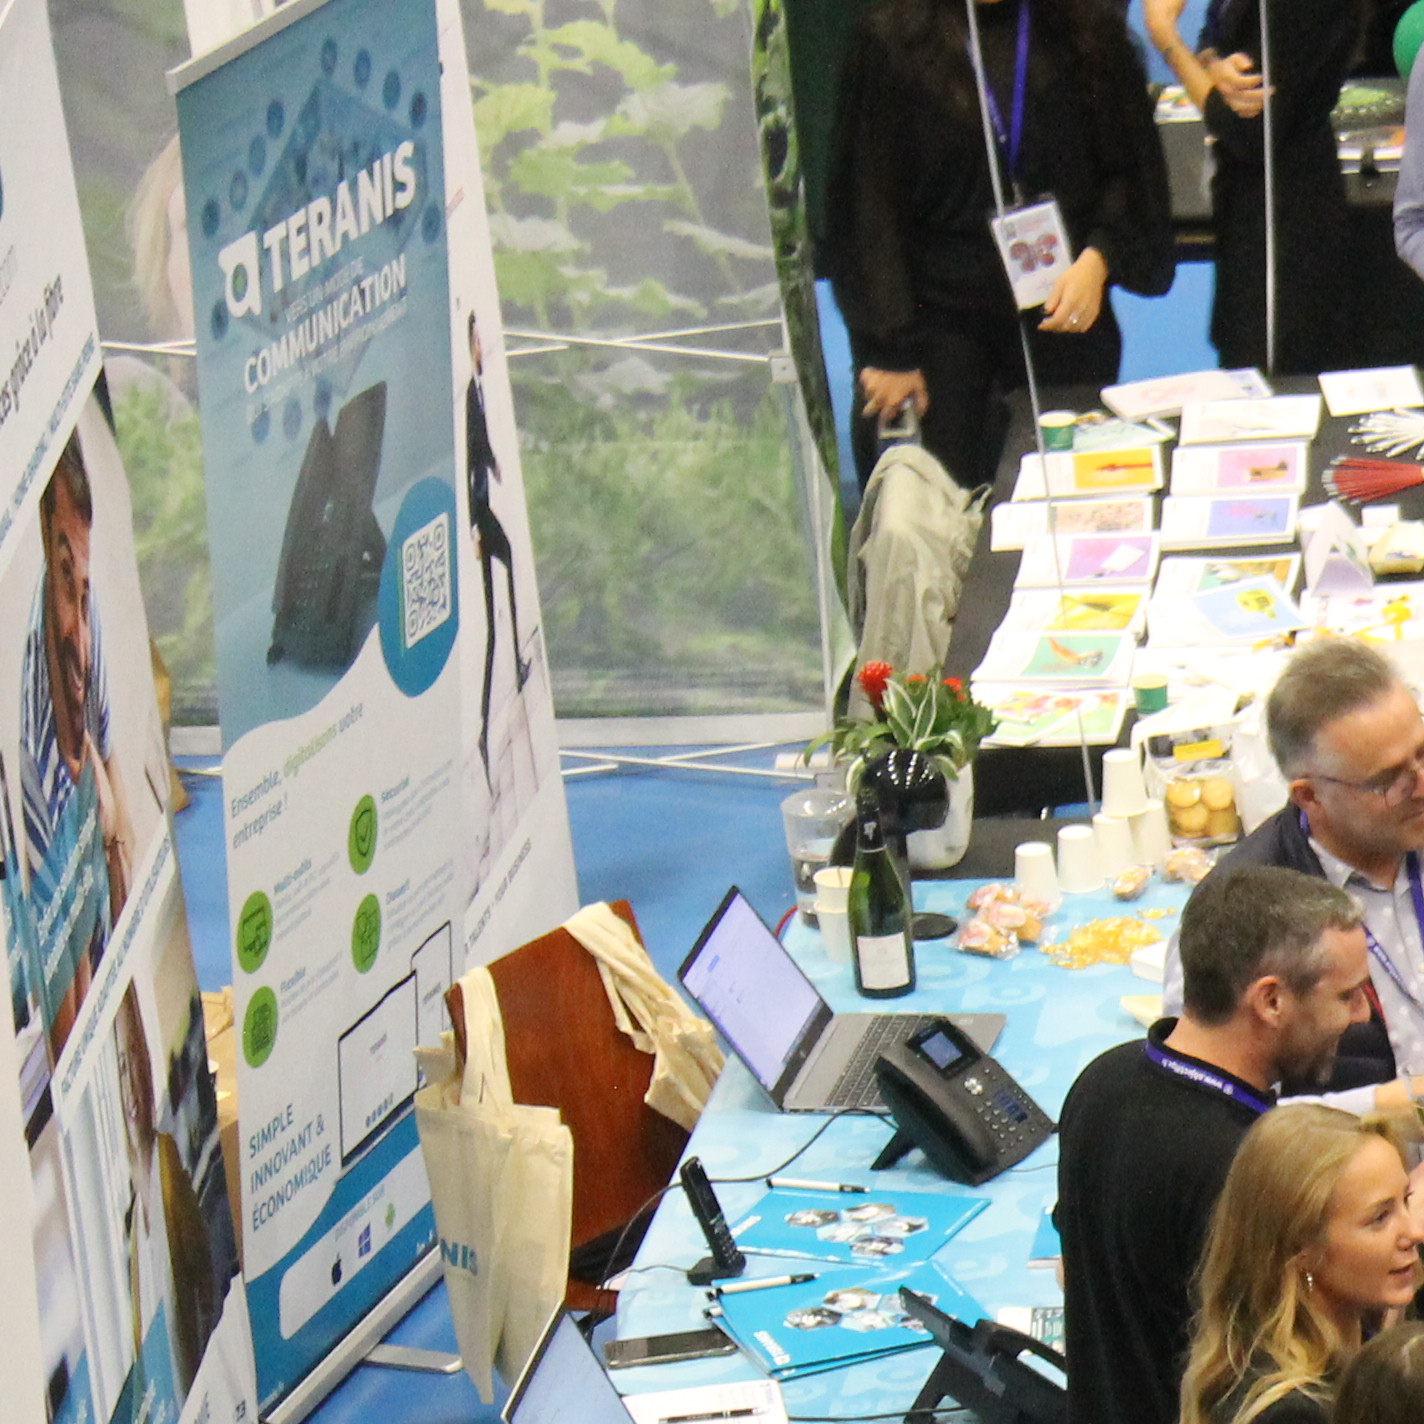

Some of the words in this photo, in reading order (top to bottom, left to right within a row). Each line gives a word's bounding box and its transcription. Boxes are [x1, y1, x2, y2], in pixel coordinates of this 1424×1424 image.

[263, 141, 415, 293] TERANIS
[244, 254, 406, 393] COMMUNICATION
[231, 770, 282, 819] Ensemble,
[232, 801, 283, 849] entreprise
[249, 1102, 295, 1159] SIMPLE
[250, 1123, 313, 1195] INNOVANT
[315, 1113, 326, 1136] &
[252, 1143, 333, 1232] ÉCONOMIQUE
